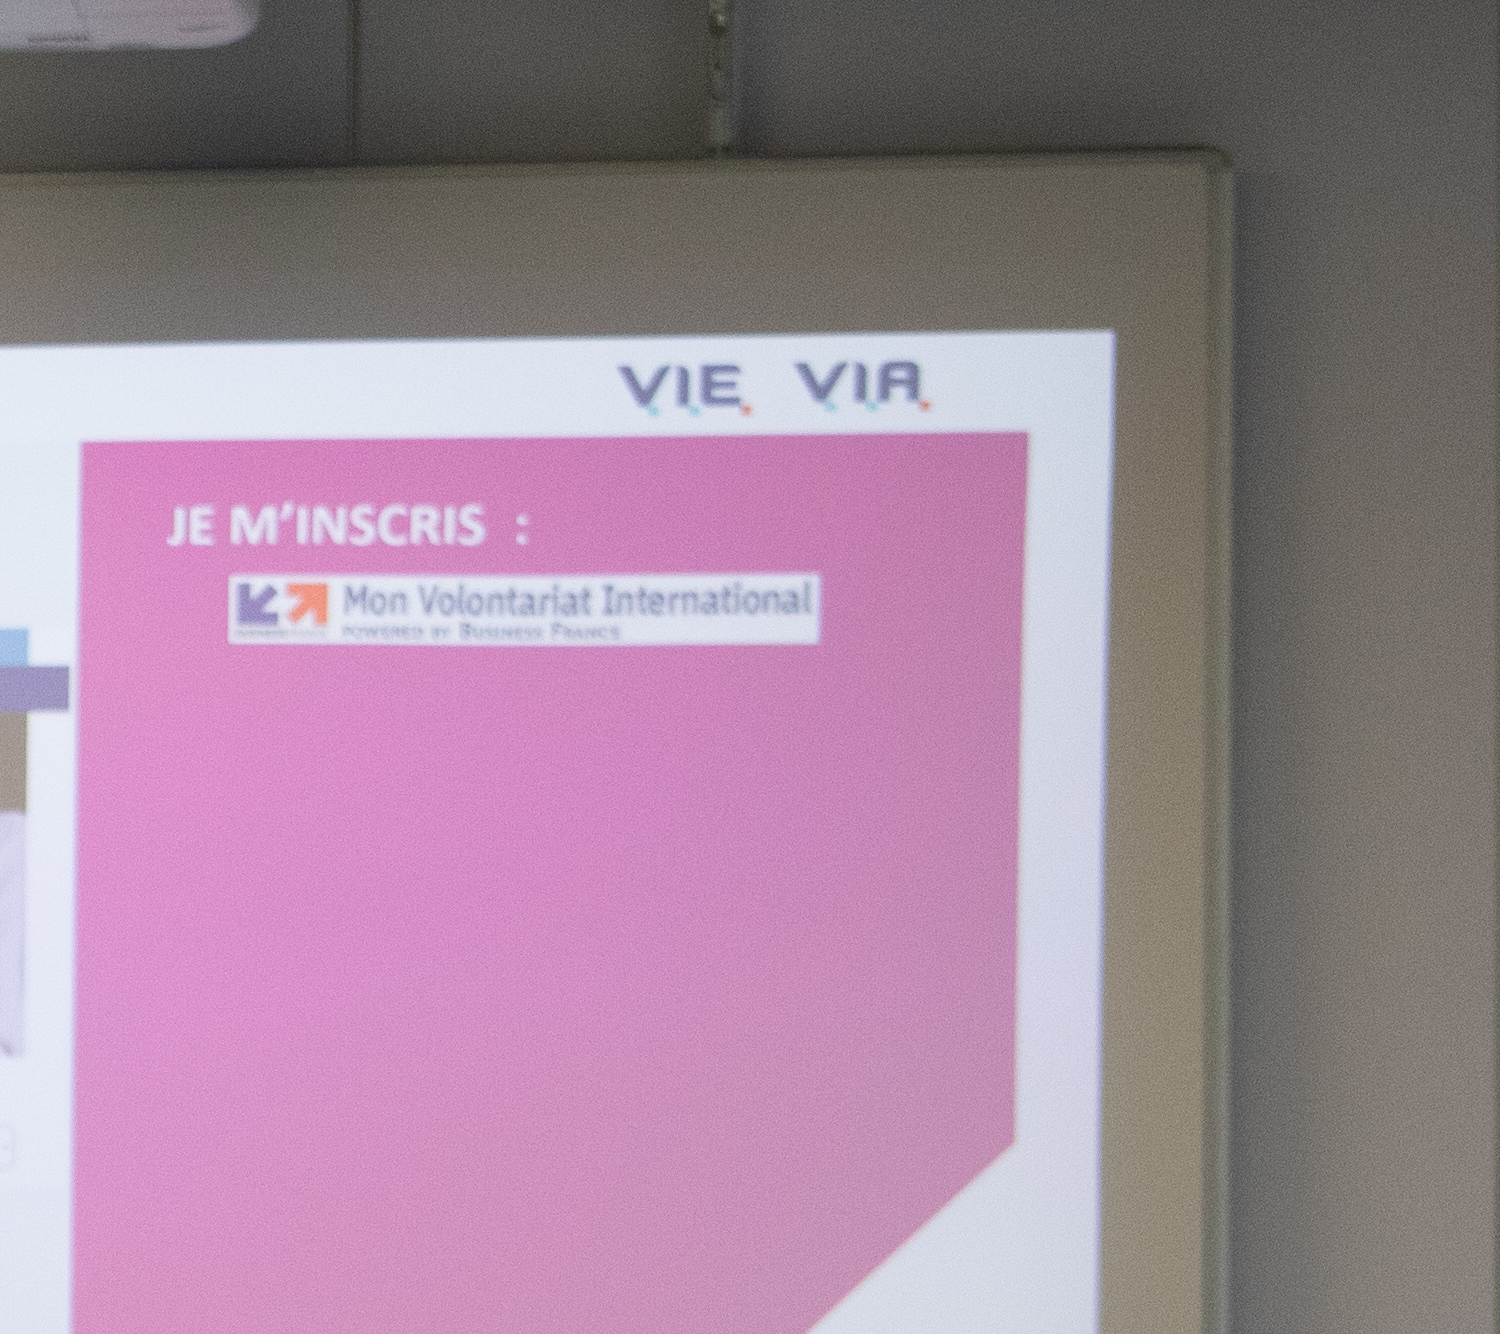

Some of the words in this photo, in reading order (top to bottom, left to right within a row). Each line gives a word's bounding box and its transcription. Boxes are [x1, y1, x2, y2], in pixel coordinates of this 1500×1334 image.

[165, 502, 216, 547] JE
[341, 584, 410, 616] Mon
[418, 582, 592, 616] Volontariat
[601, 580, 812, 616] International
